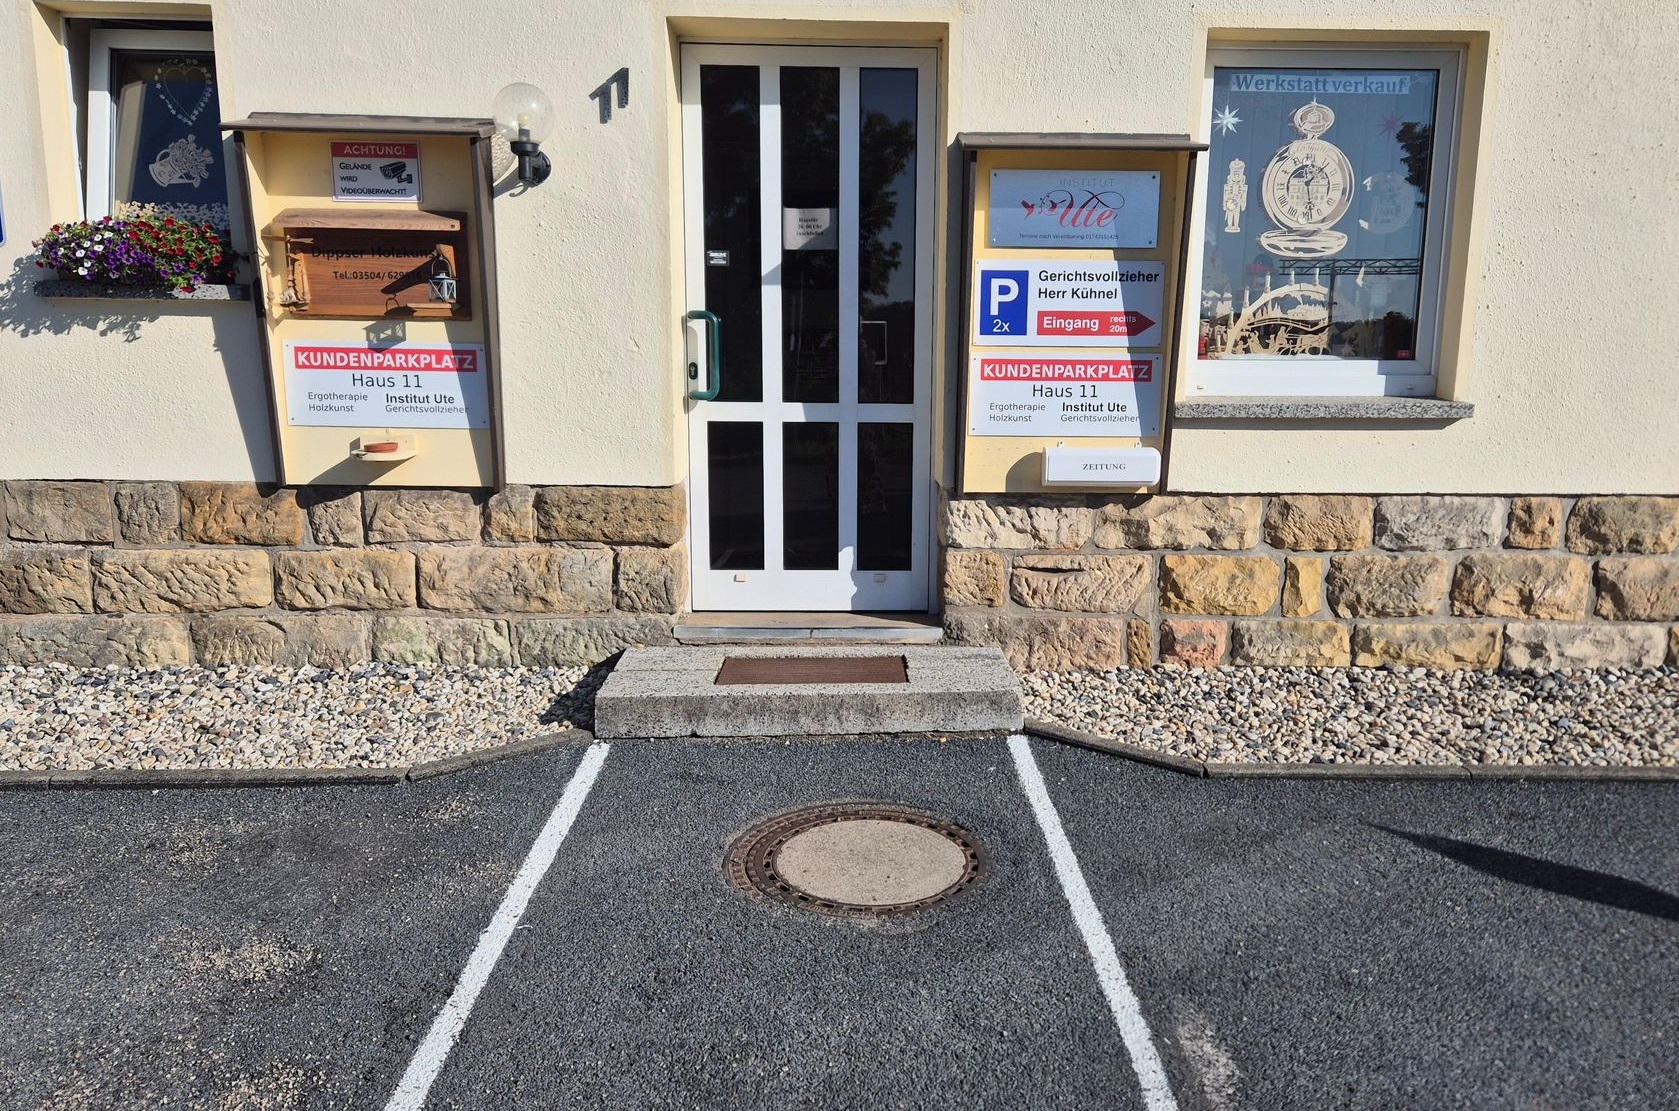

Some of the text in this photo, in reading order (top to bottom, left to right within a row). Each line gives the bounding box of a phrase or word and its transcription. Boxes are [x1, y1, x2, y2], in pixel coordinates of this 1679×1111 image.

[1235, 74, 1407, 94] Werkstattverkauf
[344, 144, 406, 156] ACHTUNG!
[1059, 178, 1115, 188] INSTITUT
[1039, 189, 1126, 228] Ute
[312, 246, 365, 261] Dippser
[1038, 270, 1160, 283] Gerichtsvollzieher
[990, 278, 1019, 316] P
[1038, 287, 1118, 299] Herr Kühnel
[1043, 316, 1099, 332] Eingang
[1110, 315, 1137, 323] rechts
[992, 319, 1010, 332] 2x
[1109, 325, 1128, 333] 20m
[297, 352, 474, 370] KUNDENPARKPLATZ
[983, 363, 1149, 379] KUNDENPARKPLATZ
[352, 373, 423, 388] Haus 11
[1032, 384, 1098, 398] Haus 11
[308, 392, 369, 403] Ergotherapie
[385, 393, 456, 405] Institut Ute
[308, 403, 355, 413] Holzkunst
[385, 404, 469, 414] Gerichtsvollzieher
[989, 402, 1046, 412] Ergotherapie
[1062, 402, 1127, 412] Institut Ute
[989, 414, 1032, 422] Holzkunst
[1060, 414, 1140, 423] Gerichtsvollzieher
[1082, 463, 1127, 471] ZEITUNG
